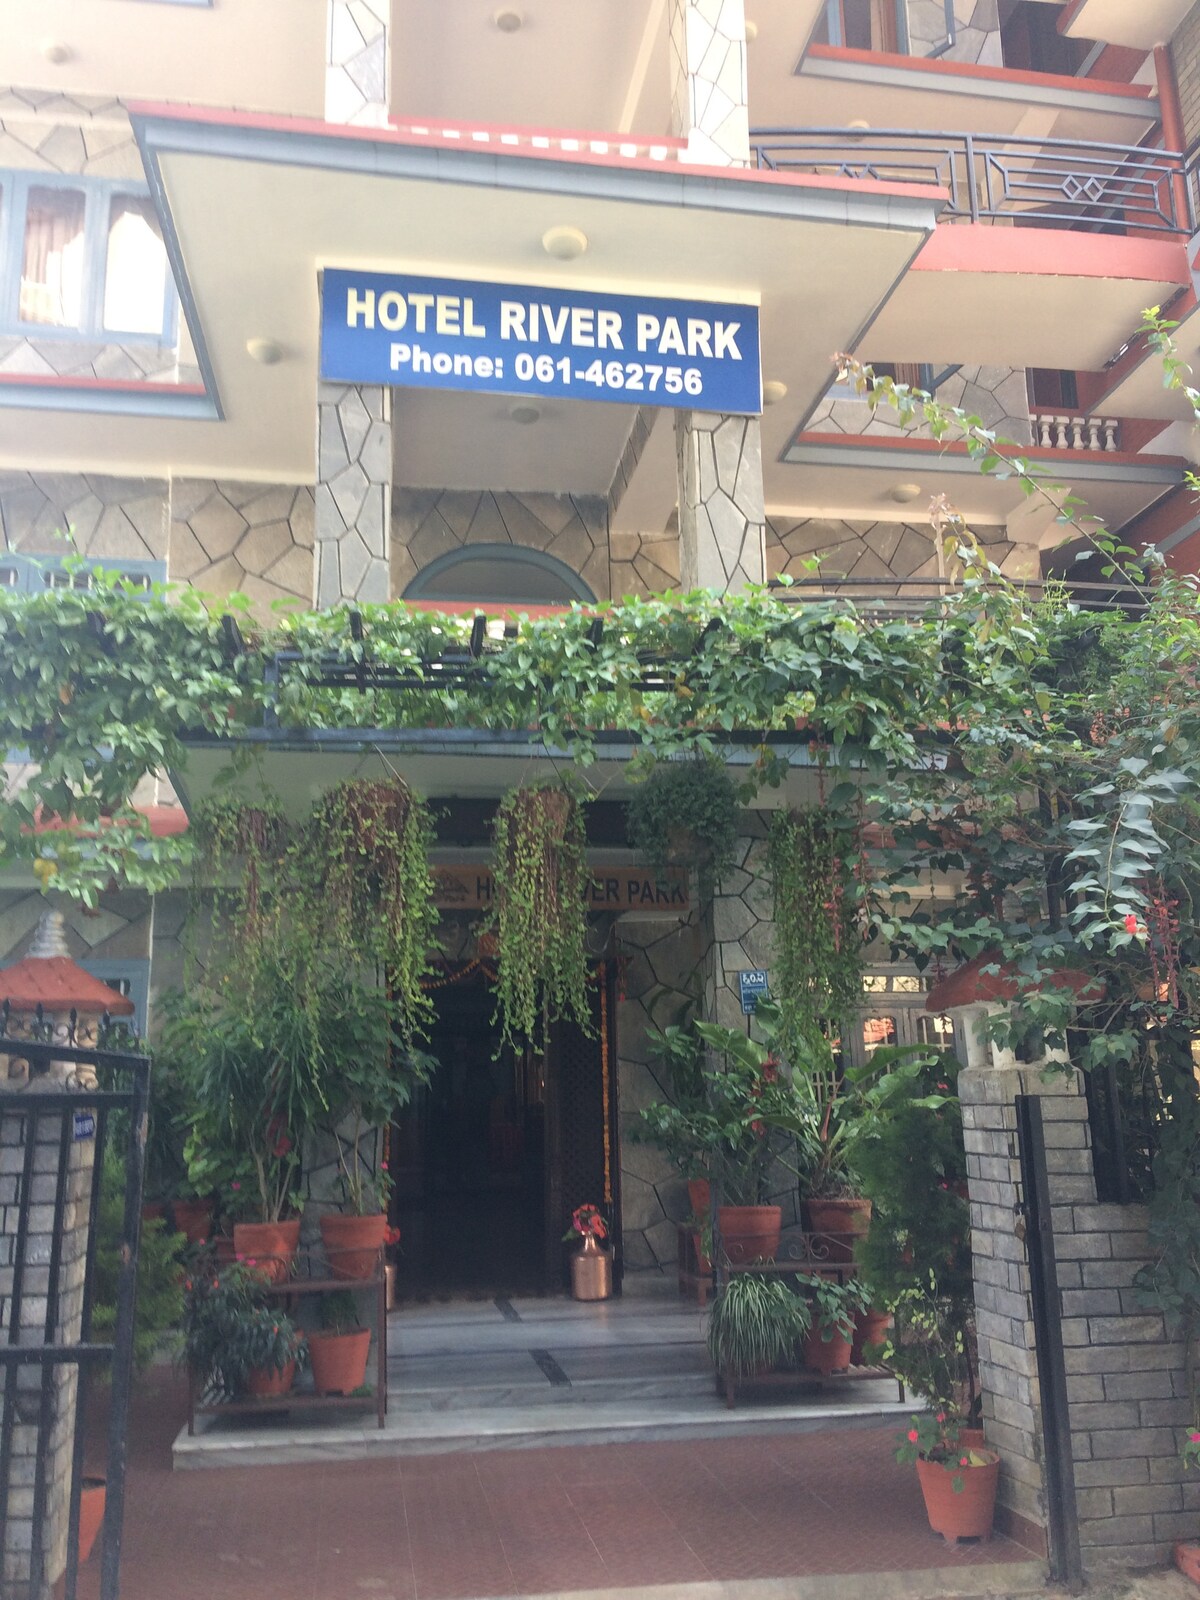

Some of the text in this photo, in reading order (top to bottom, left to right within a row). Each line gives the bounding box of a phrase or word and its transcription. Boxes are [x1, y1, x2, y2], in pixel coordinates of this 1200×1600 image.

[346, 287, 743, 360] HOTEL RIVER PARK
[390, 343, 703, 396] Phone: 061-462756
[628, 880, 686, 904] PARK
